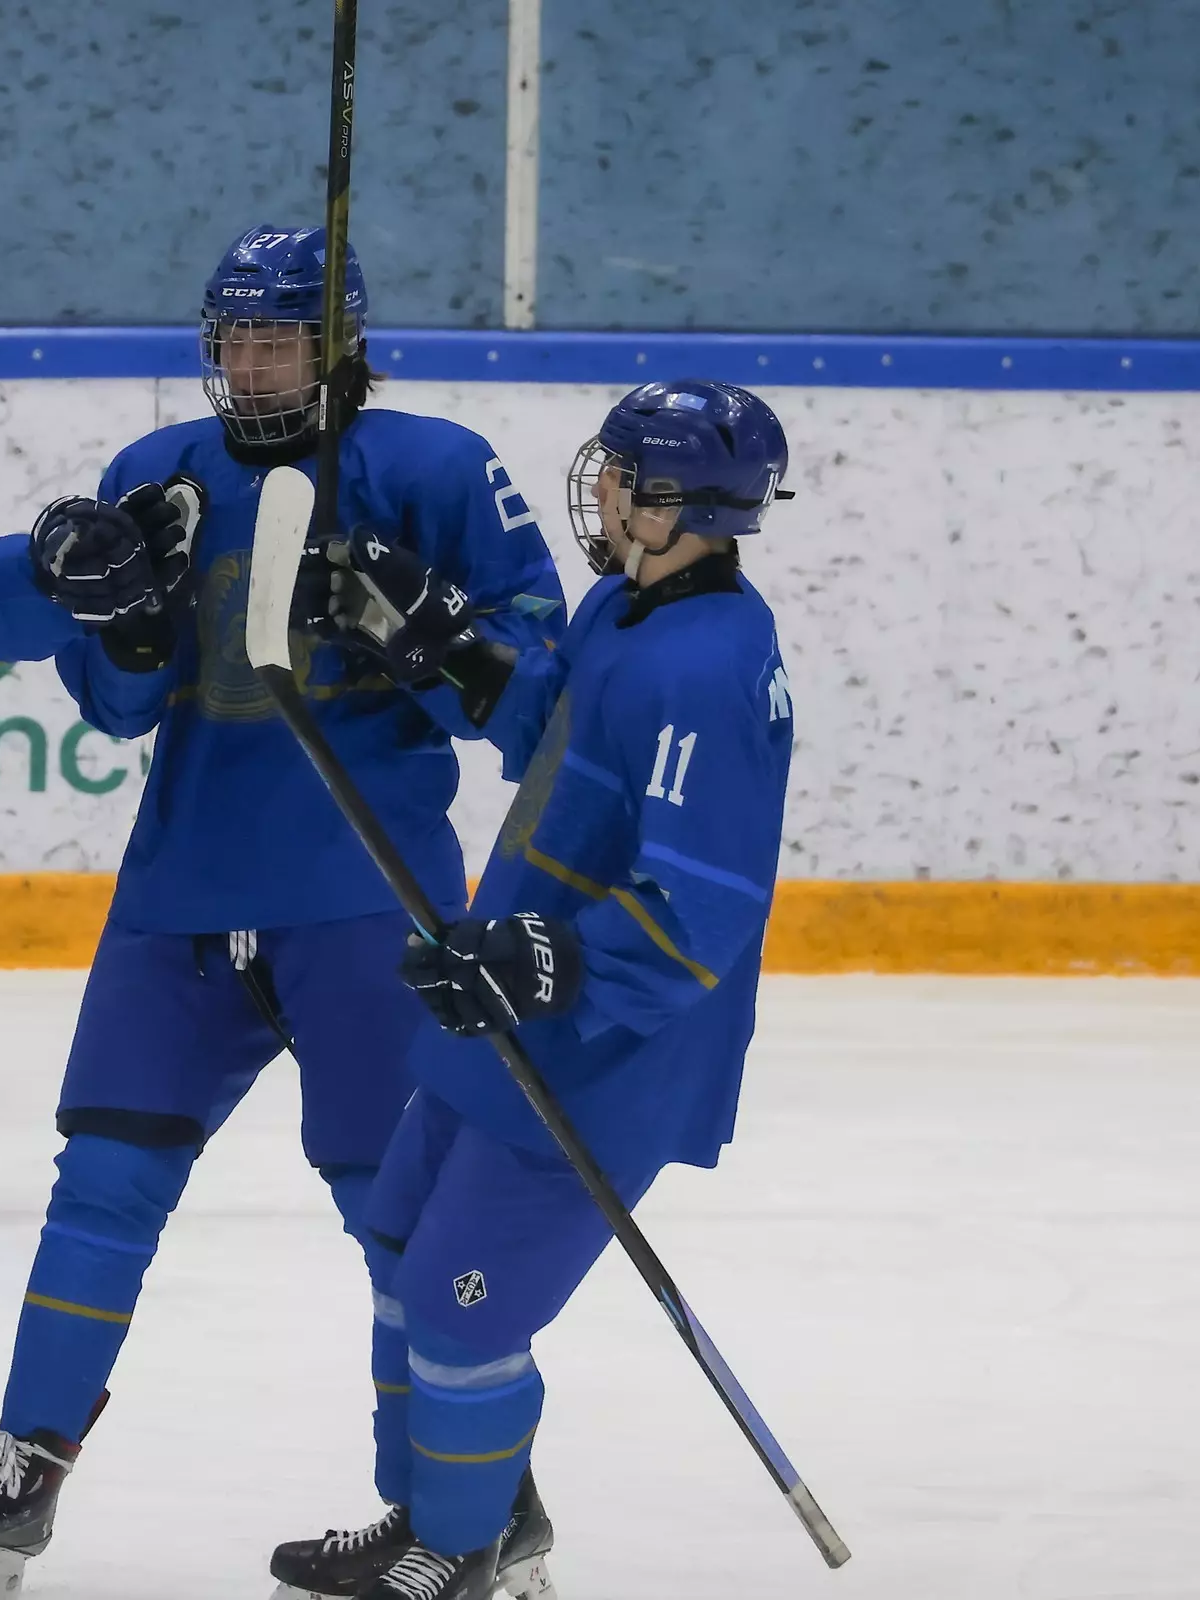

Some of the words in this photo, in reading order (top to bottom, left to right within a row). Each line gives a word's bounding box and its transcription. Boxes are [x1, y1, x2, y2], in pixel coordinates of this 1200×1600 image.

[341, 125, 349, 158] PRO
[249, 233, 288, 249] 27
[222, 287, 265, 297] CCM
[345, 290, 359, 301] CM
[642, 436, 682, 447] BAUER
[645, 724, 697, 806] 11
